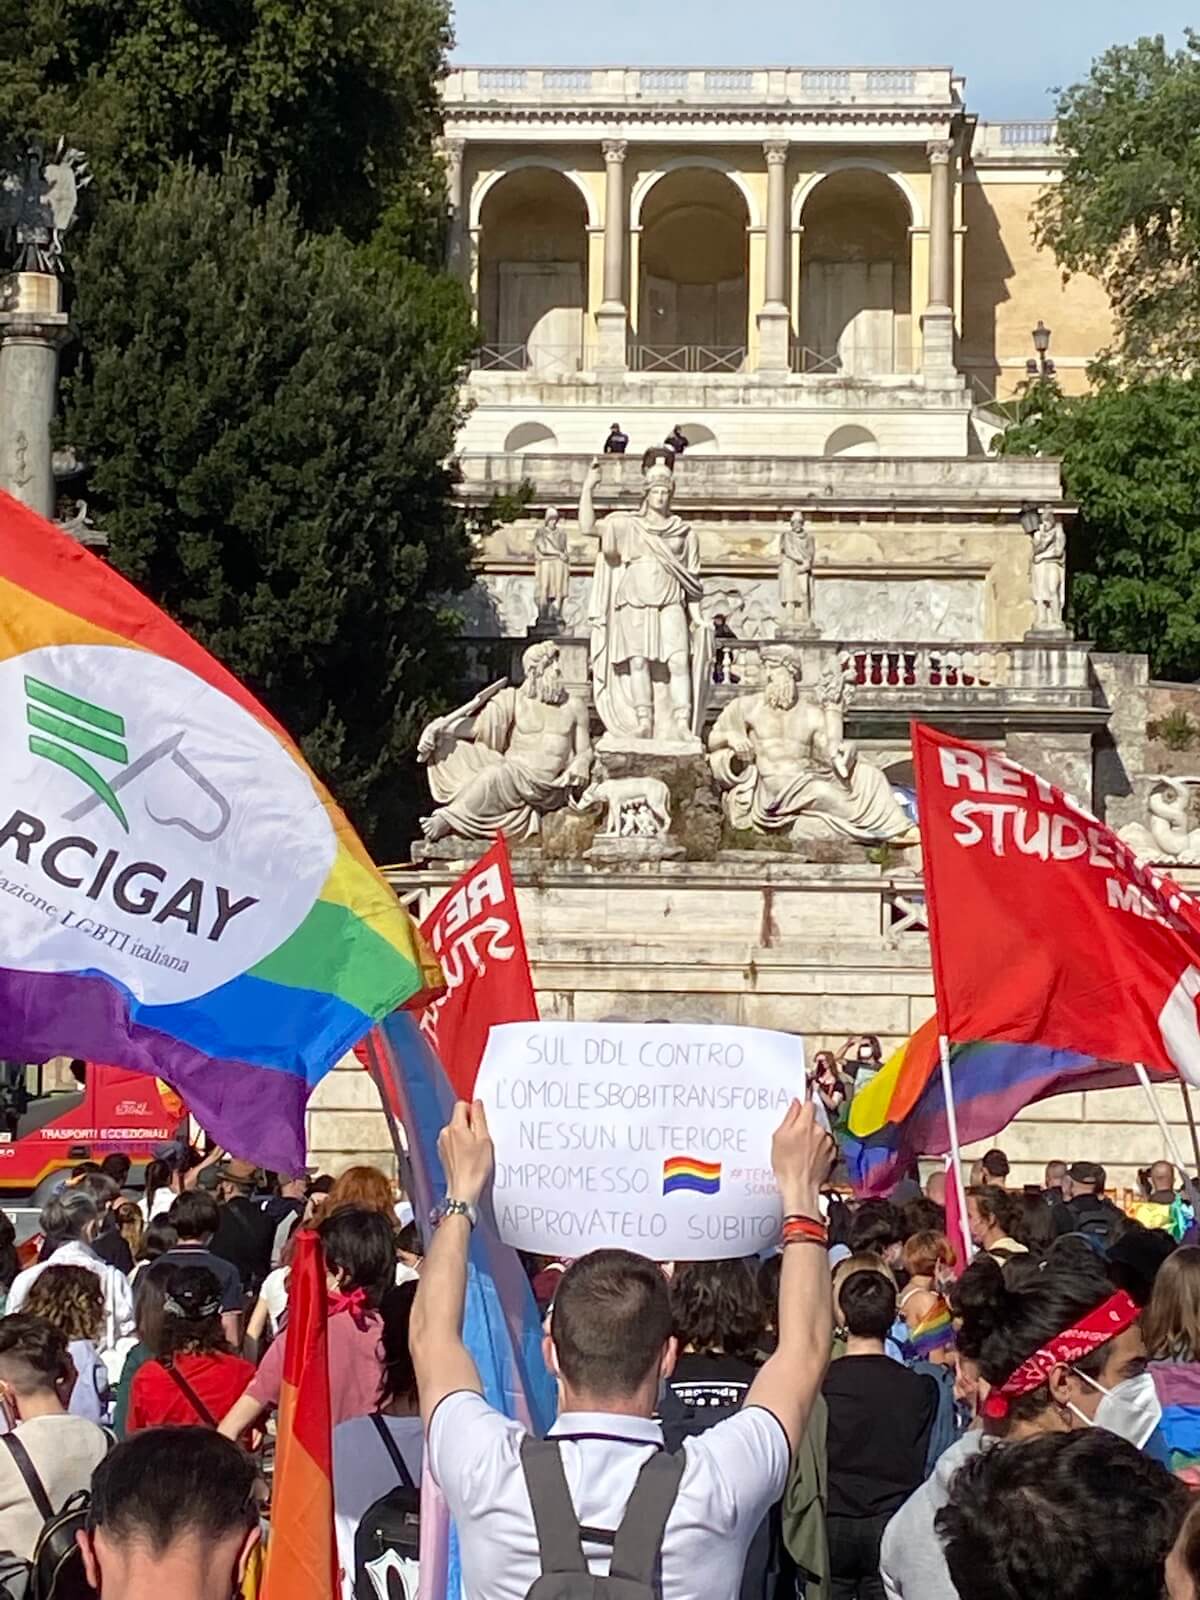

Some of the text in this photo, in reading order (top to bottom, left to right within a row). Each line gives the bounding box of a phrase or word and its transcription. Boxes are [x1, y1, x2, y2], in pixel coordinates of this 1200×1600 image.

[951, 799, 1126, 871] STUDE
[0, 809, 260, 942] RCIGAY
[0, 876, 190, 974] azione LGBTI italiana
[526, 1034, 744, 1068] SUL DDL CONTRO
[496, 1078, 789, 1110] L'OMOLESBOBITRANSFOBIA
[40, 1129, 168, 1140] TRASPORTI ECCEZIONALI
[519, 1121, 747, 1152] NESSUN ULTERIORE
[496, 1162, 649, 1194] OMPROMESSO
[502, 1204, 779, 1240] APPROVATELO SUBITO
